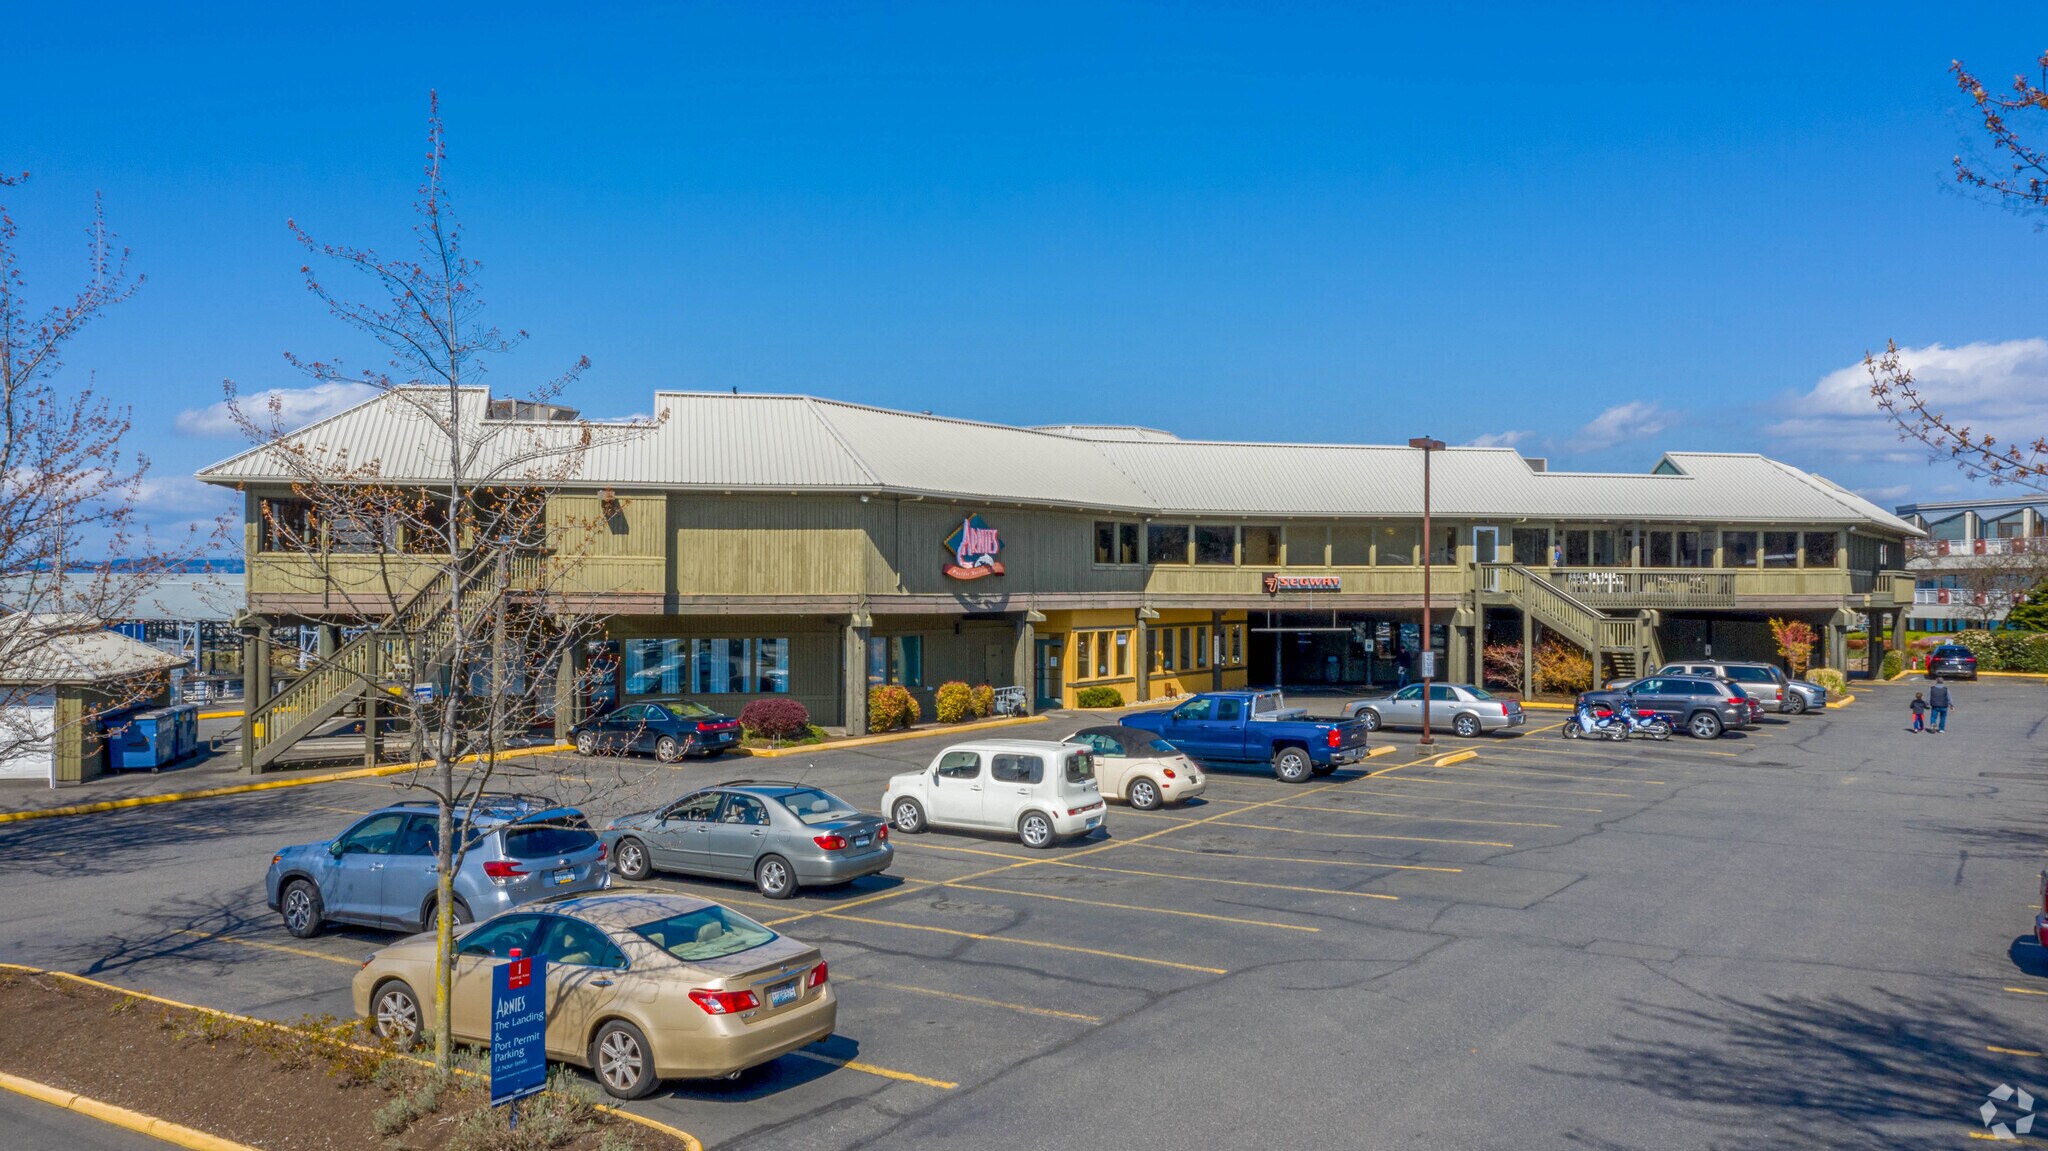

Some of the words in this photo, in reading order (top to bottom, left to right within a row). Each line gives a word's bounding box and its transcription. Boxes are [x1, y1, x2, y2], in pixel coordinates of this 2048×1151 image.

[957, 518, 999, 558] ARNIES
[1279, 577, 1339, 587] SEGWAY
[518, 962, 522, 974] 1
[496, 995, 525, 1019] ARNIES
[495, 1021, 510, 1031] The
[512, 1011, 544, 1026] Landing
[495, 1032, 502, 1042] &
[495, 1042, 511, 1053] Port
[514, 1032, 540, 1047] Permit
[495, 1048, 525, 1063] Parking
[501, 1062, 514, 1071] hour
[514, 1057, 528, 1067] limit)
